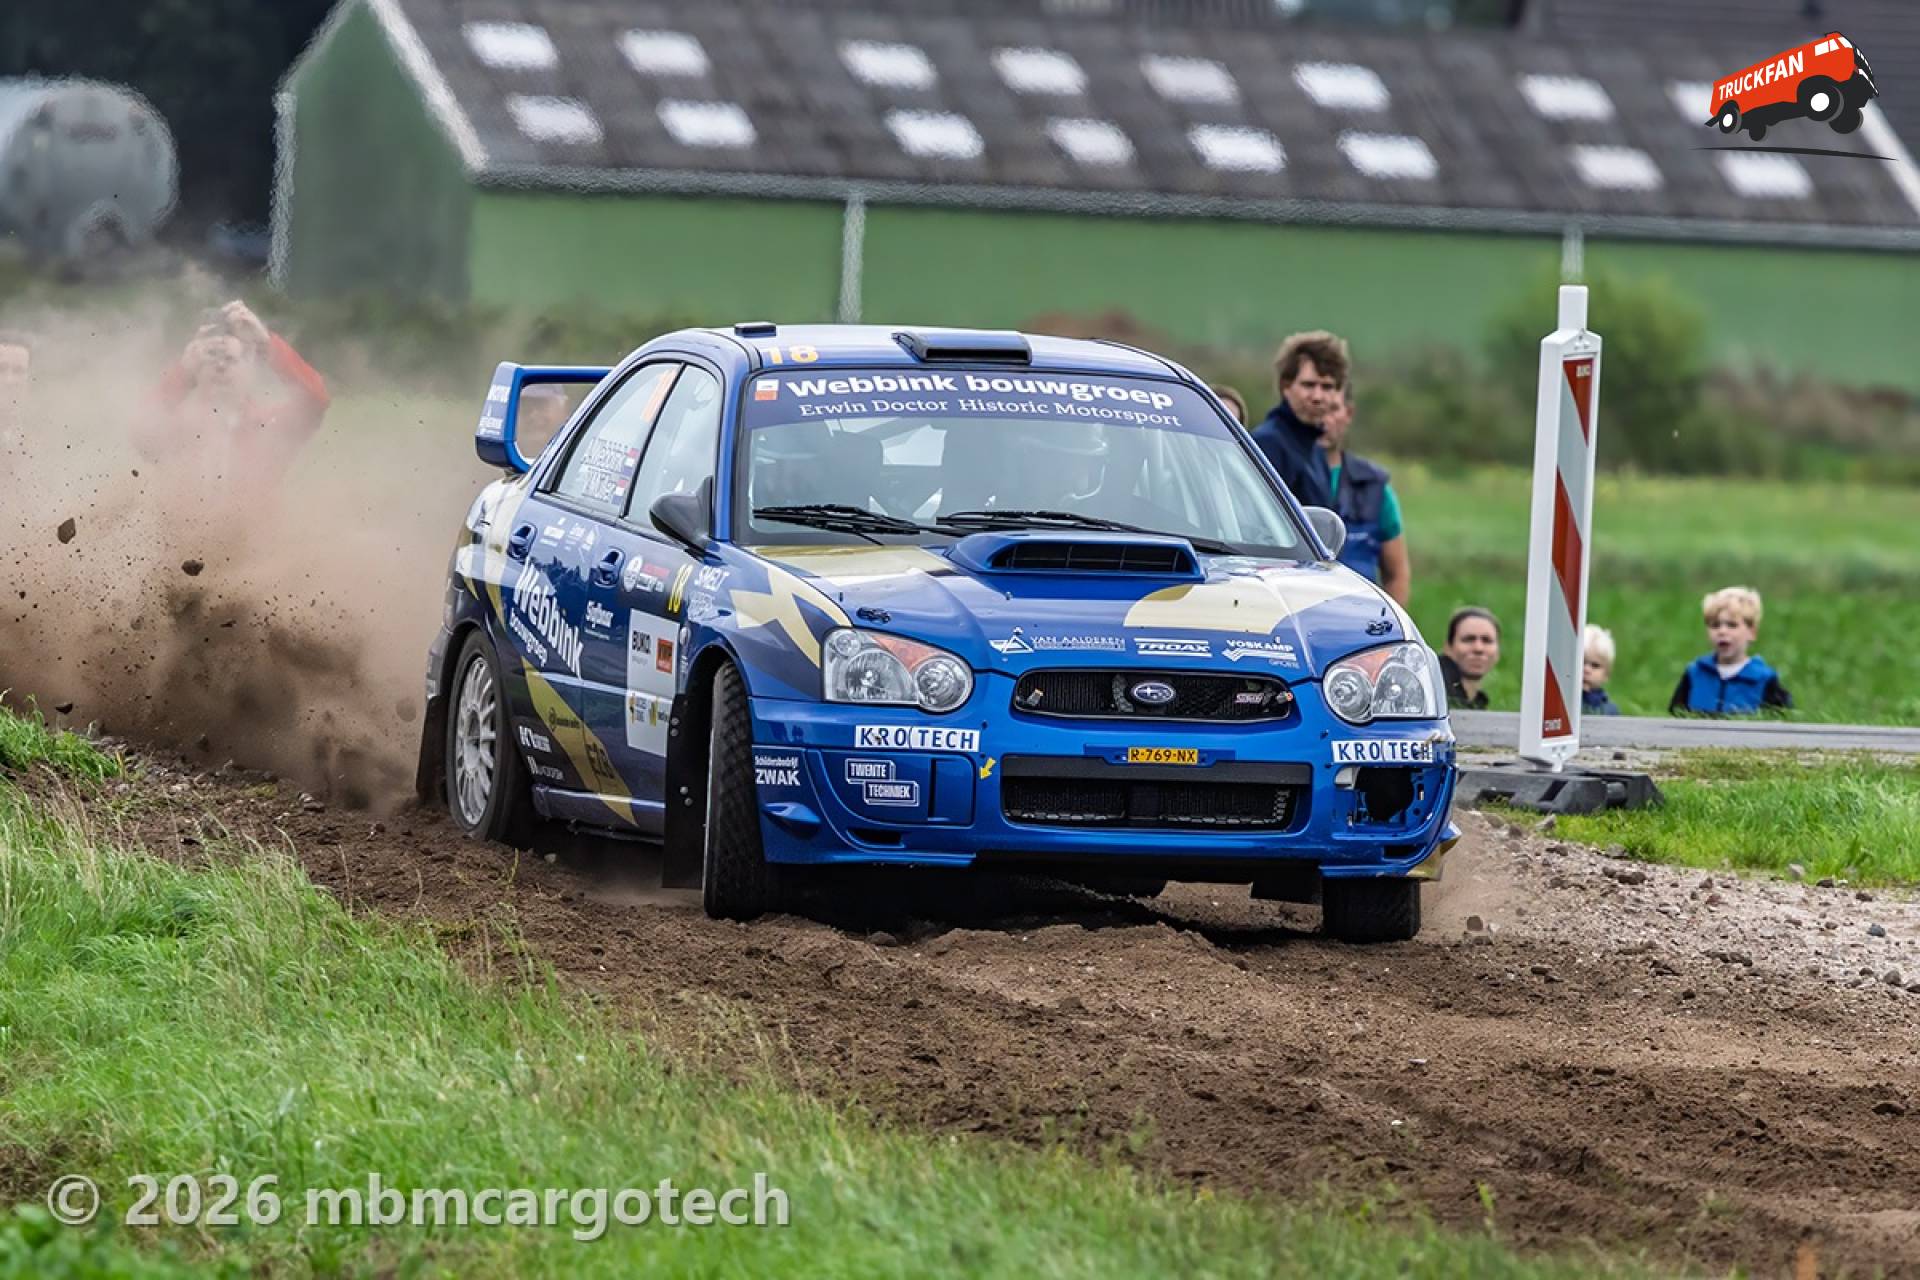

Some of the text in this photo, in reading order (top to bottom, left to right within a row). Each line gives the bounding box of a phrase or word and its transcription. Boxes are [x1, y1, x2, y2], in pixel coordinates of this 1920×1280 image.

[786, 374, 1174, 409] Webbink bouwgroep
[800, 399, 1182, 427] Erwin Doctor Historic Motorsport
[513, 555, 584, 681] Webbink
[1226, 639, 1294, 652] VOSKAMP
[1130, 749, 1196, 763] R-769-NX
[755, 769, 801, 786] ZWAK
[850, 763, 887, 778] TWENTE
[868, 783, 911, 798] TECHNIEK
